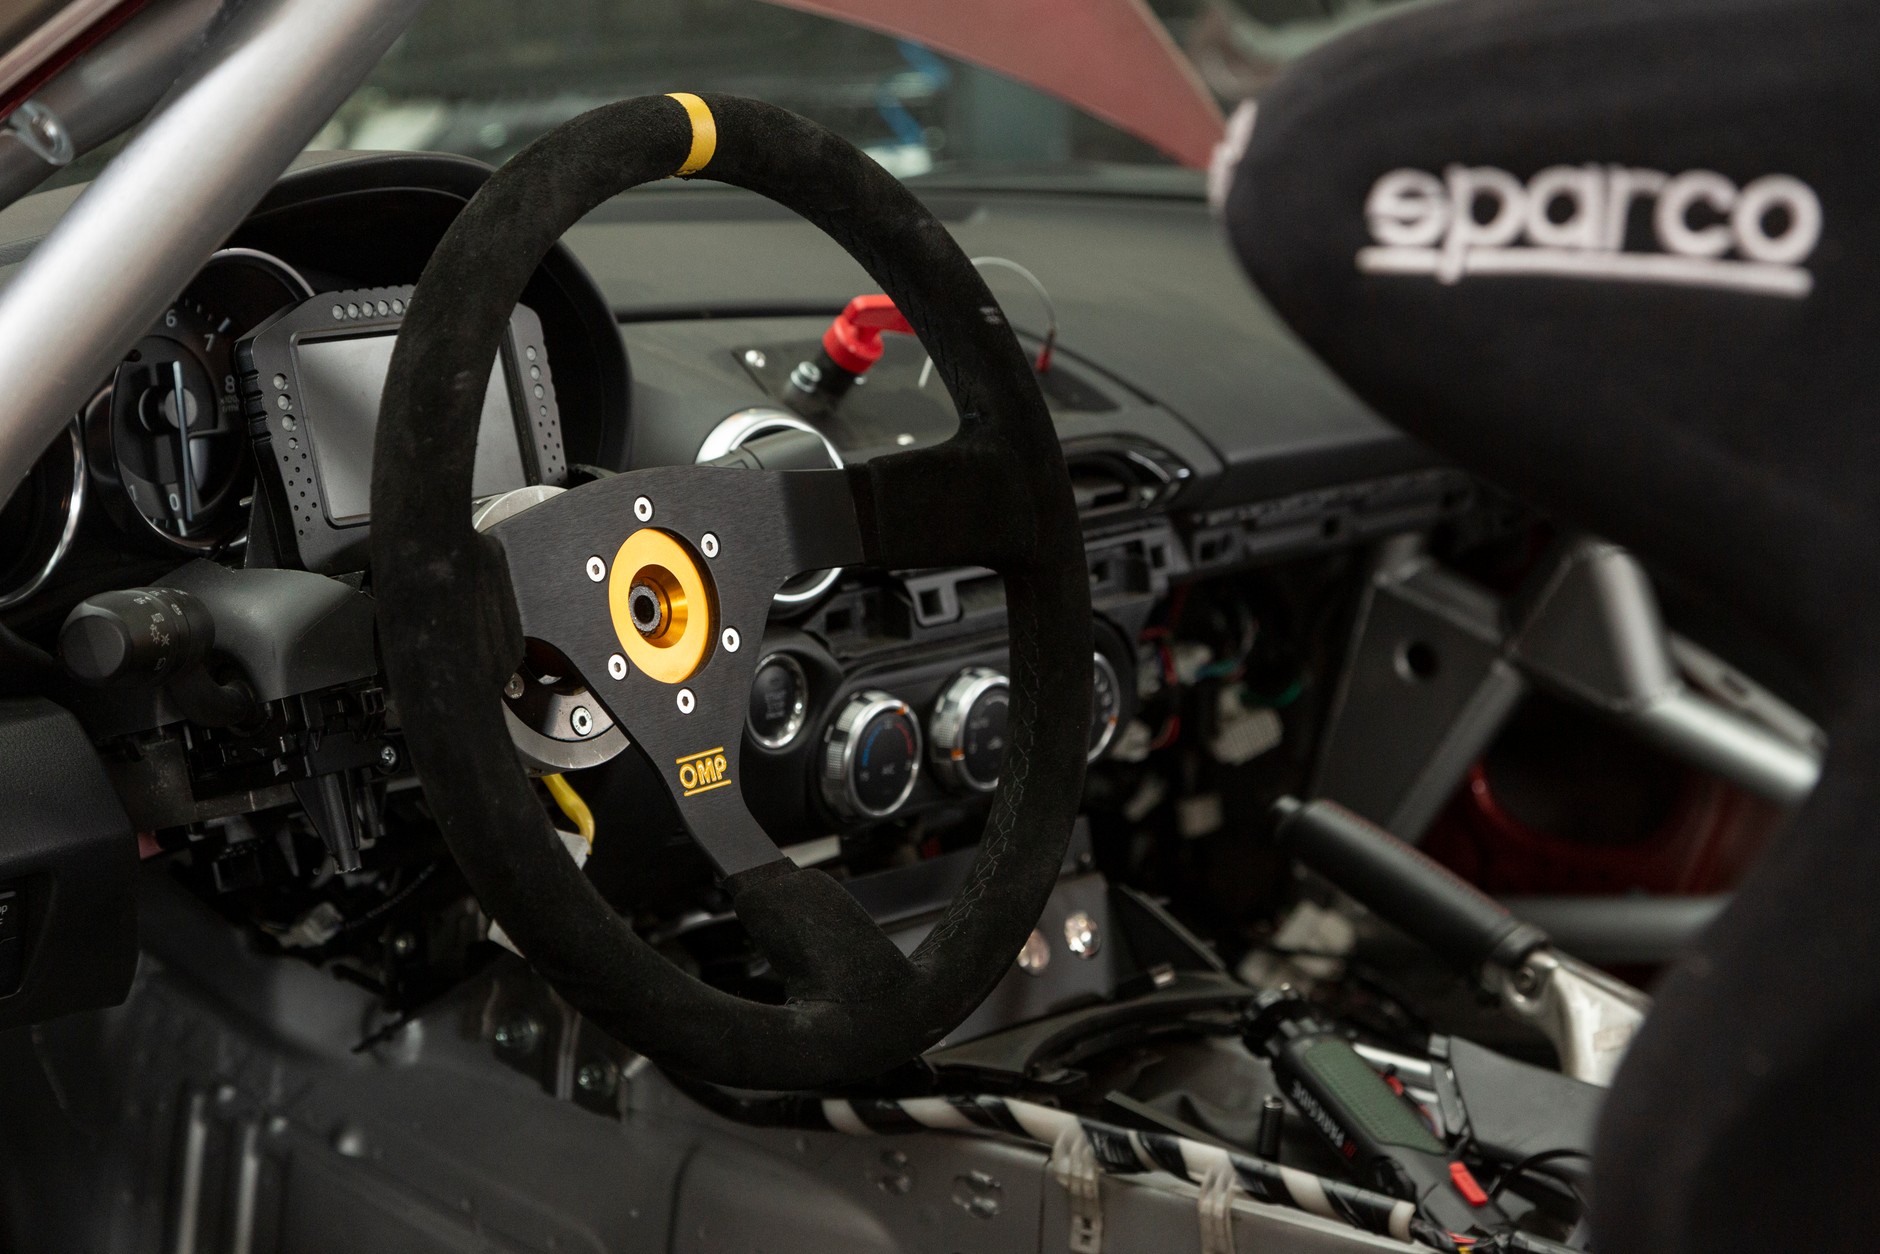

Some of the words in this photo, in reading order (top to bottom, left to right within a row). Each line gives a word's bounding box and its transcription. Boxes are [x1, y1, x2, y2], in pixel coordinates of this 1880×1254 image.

[1365, 163, 1823, 284] sparco
[166, 309, 177, 328] 6
[204, 333, 215, 352] 7
[225, 375, 236, 393] 8
[129, 485, 137, 501] 1
[169, 493, 179, 511] 0
[679, 754, 727, 789] OMP
